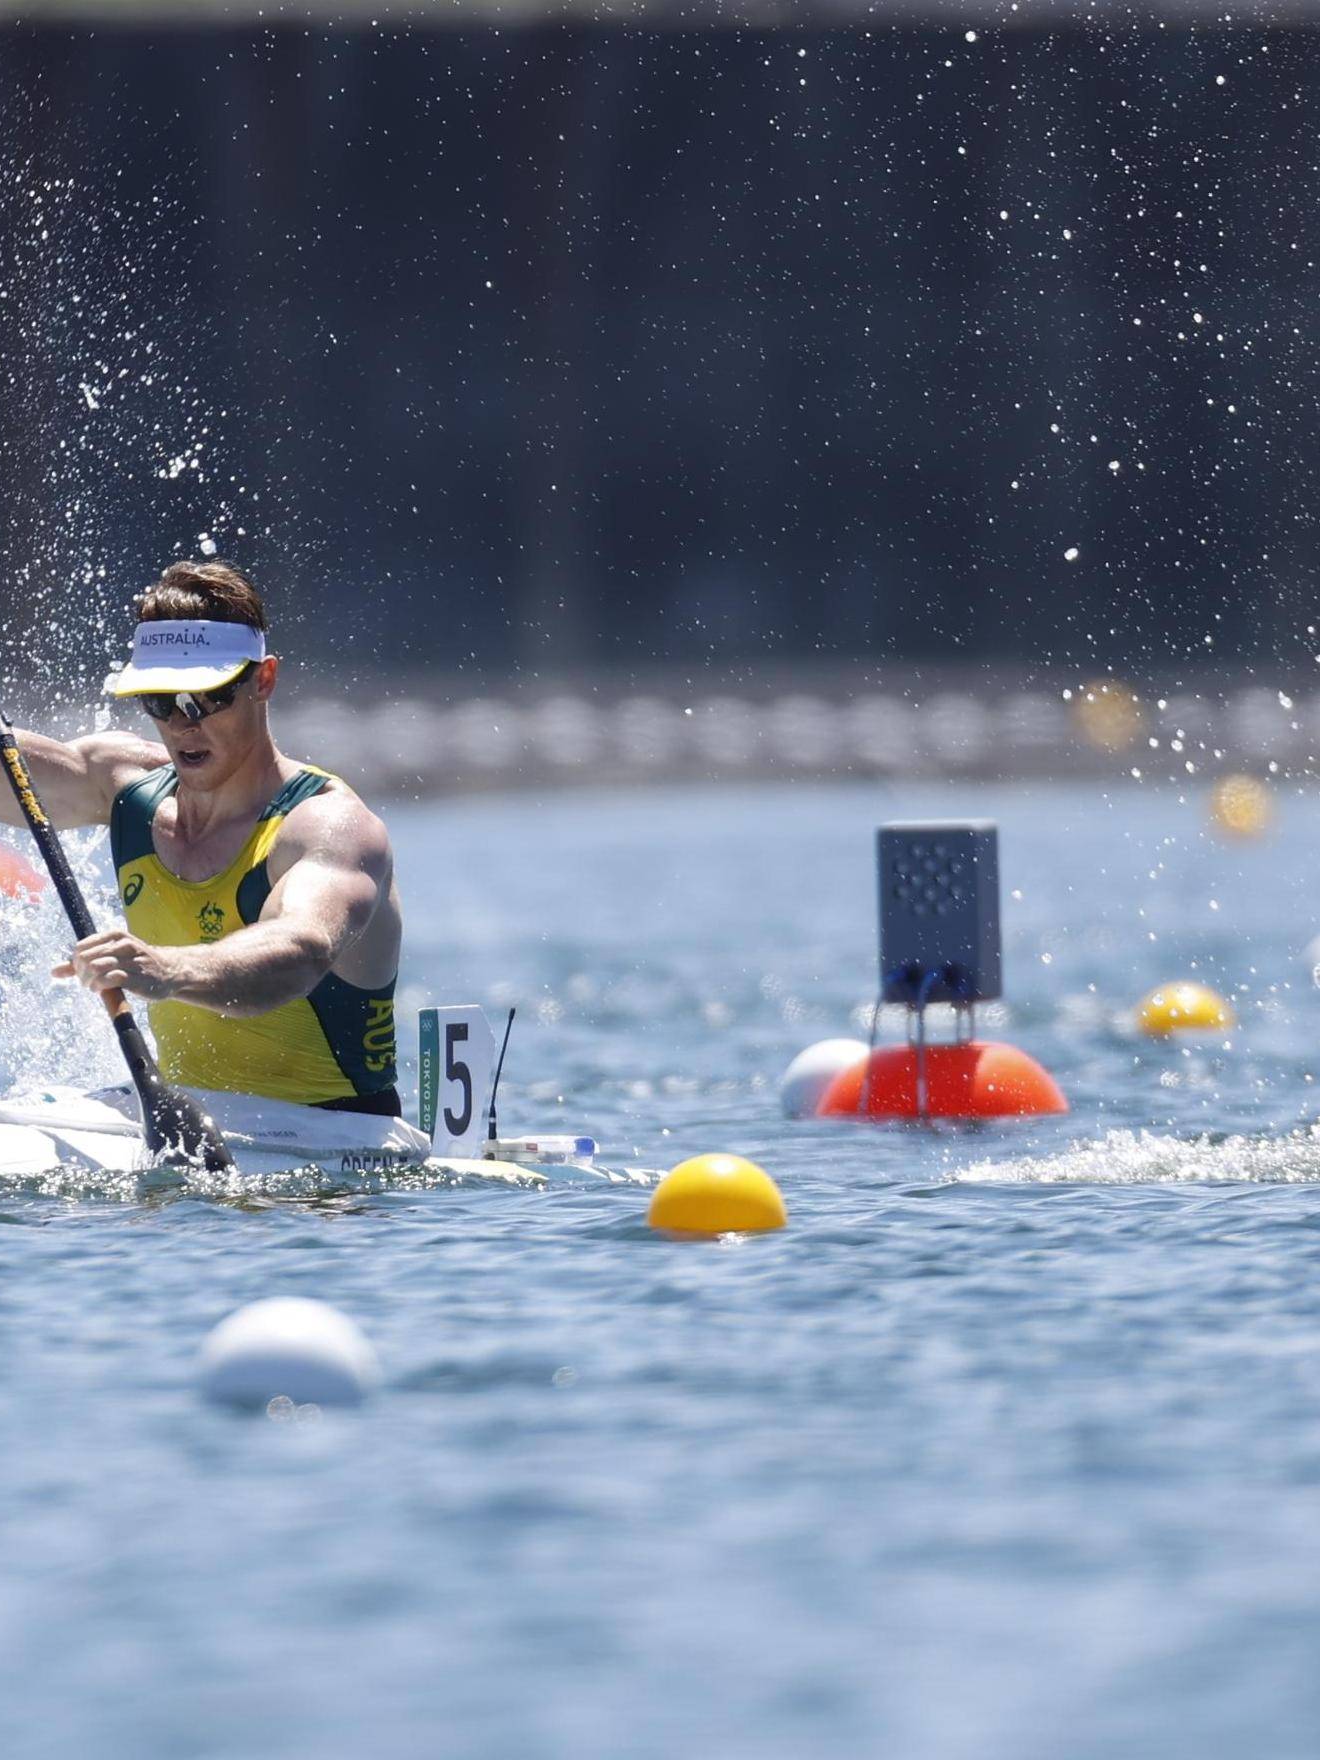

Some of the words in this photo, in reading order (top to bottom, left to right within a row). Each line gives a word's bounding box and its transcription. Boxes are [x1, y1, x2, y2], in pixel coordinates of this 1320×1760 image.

[362, 999, 397, 1073] AUS
[423, 1048, 432, 1100] TOKYO
[443, 1022, 472, 1137] 5
[423, 1103, 432, 1133] 202
